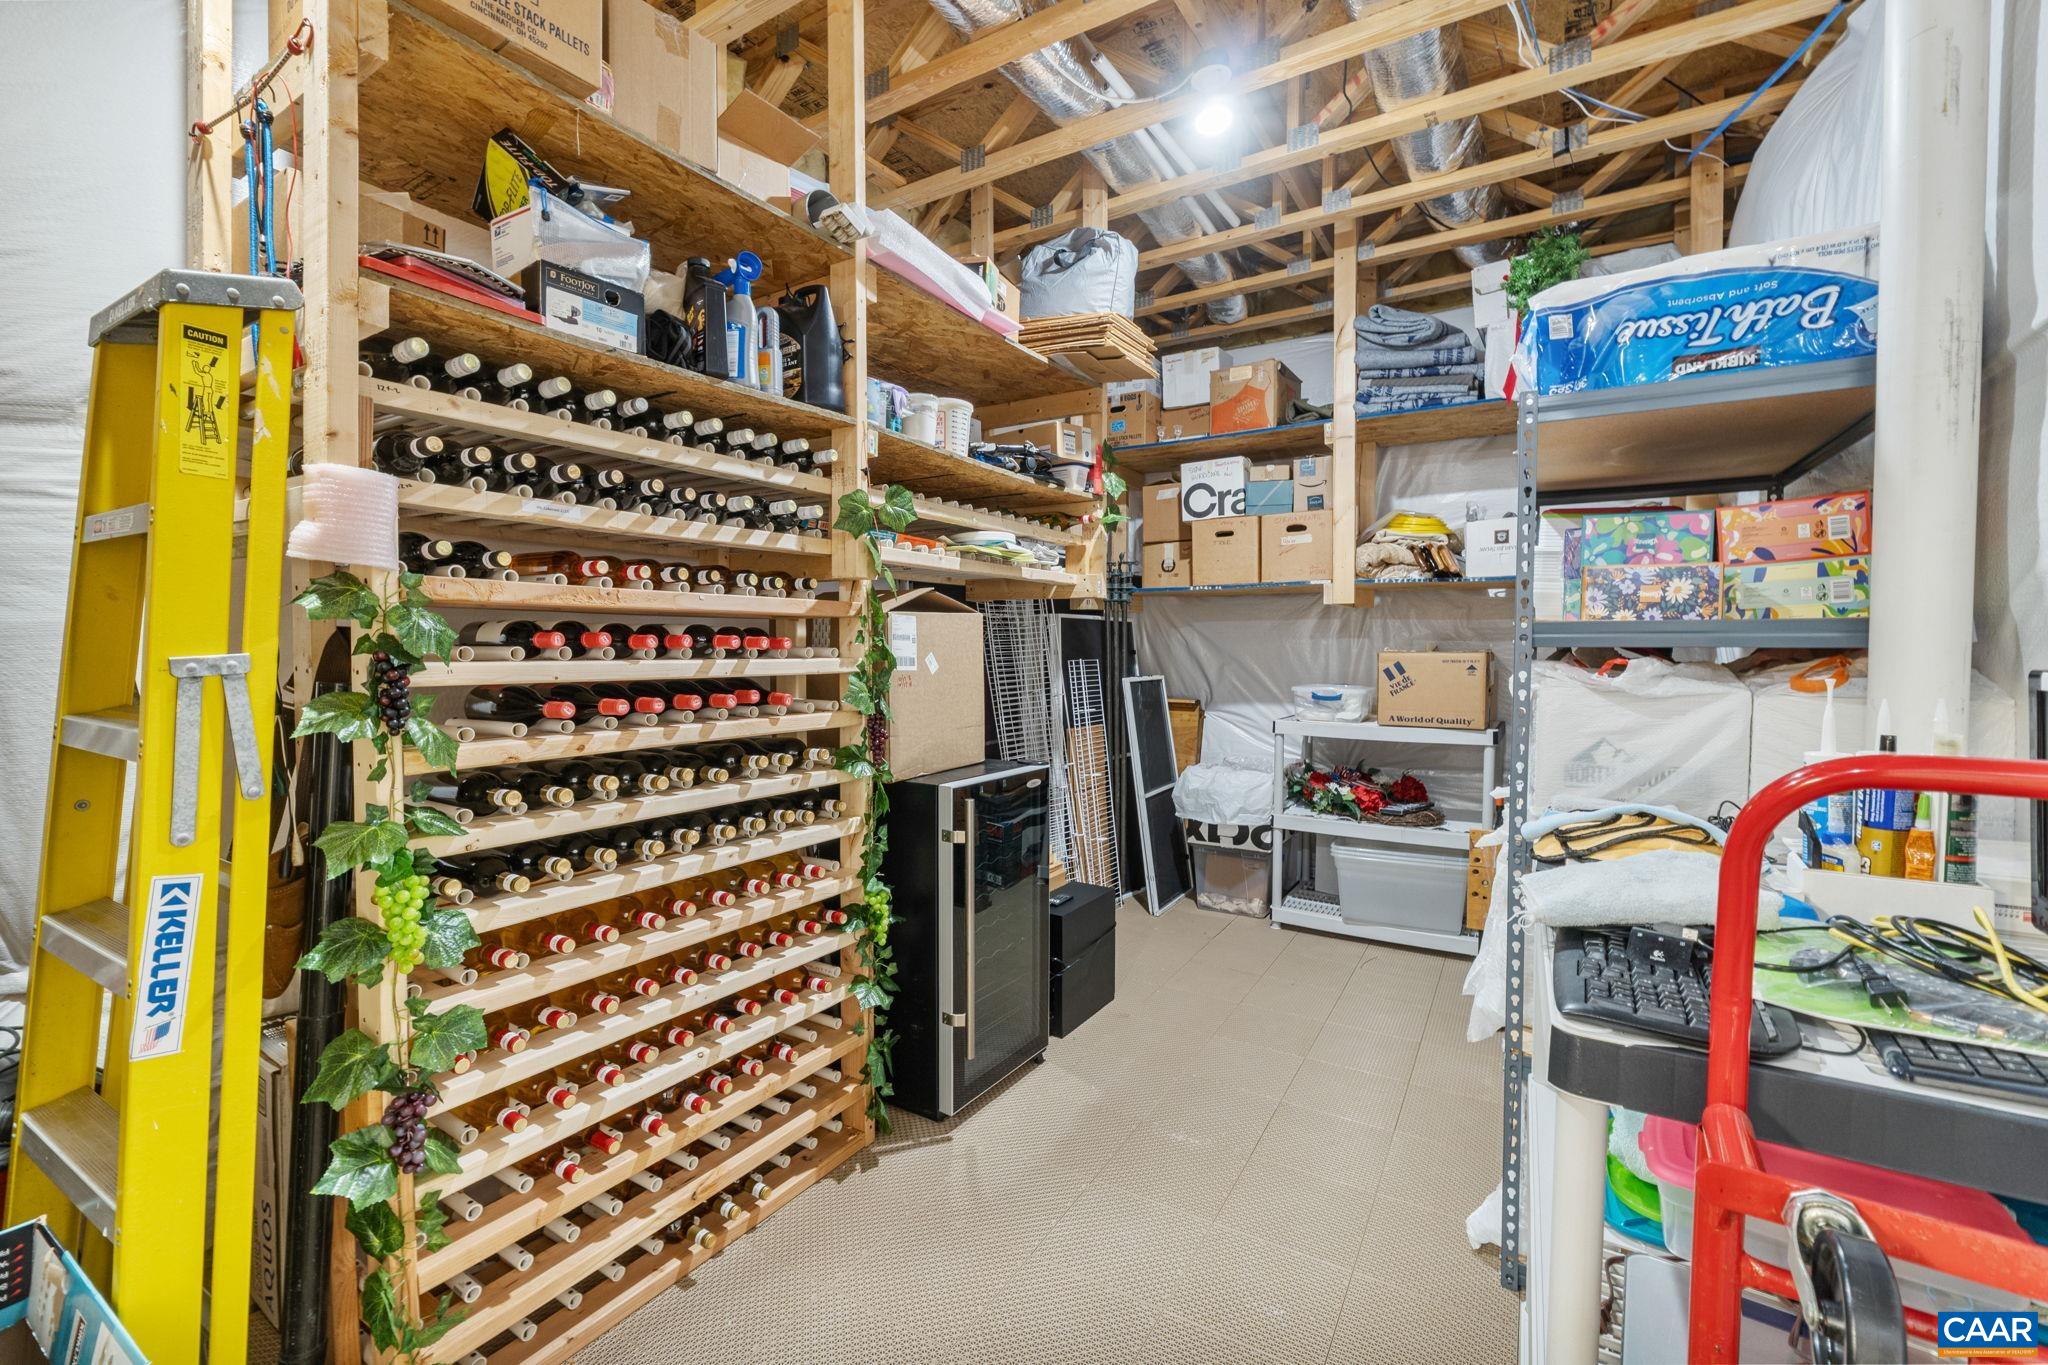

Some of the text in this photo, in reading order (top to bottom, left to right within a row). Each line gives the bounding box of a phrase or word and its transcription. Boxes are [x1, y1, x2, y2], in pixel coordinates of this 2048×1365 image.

[496, 7, 526, 29] KROGER
[514, 1, 546, 32] STACK
[549, 22, 590, 56] PALLETS
[517, 27, 527, 39] OH
[1668, 279, 1778, 308] Soft and Absorbent
[1616, 285, 1841, 350] Bath Tissue
[187, 328, 224, 346] CAUTION
[1674, 353, 1759, 377] KIRKLAND
[1389, 674, 1412, 689] VIE de
[1390, 681, 1416, 697] FRANCE
[1395, 715, 1424, 723] World
[1424, 716, 1435, 724] of
[1436, 716, 1472, 727] Quality
[146, 909, 187, 1018] KELLER
[261, 1199, 275, 1315] AQUOS
